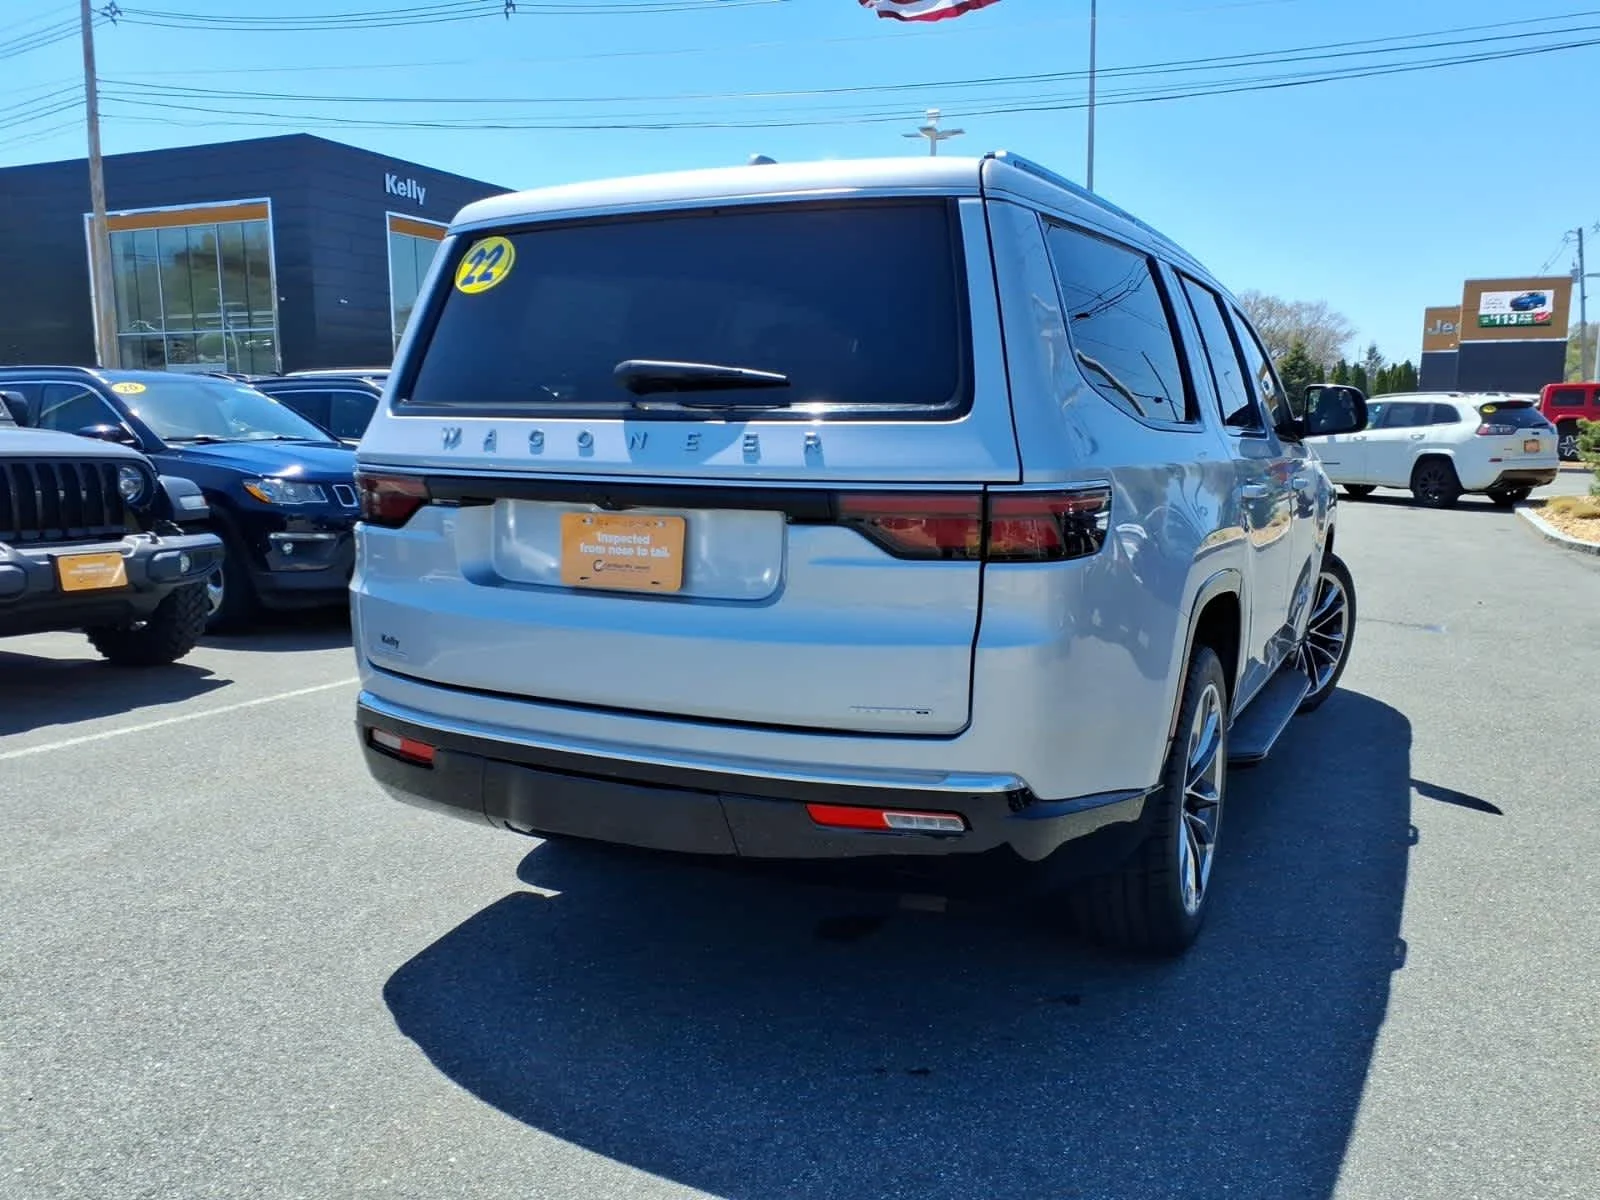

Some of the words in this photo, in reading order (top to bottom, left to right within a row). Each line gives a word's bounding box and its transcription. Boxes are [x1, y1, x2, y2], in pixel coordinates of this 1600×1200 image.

[384, 173, 426, 205] Kelly
[461, 243, 505, 286] 22
[441, 426, 823, 455] WAGONEER
[580, 542, 606, 554] from
[597, 533, 650, 546] Inspected
